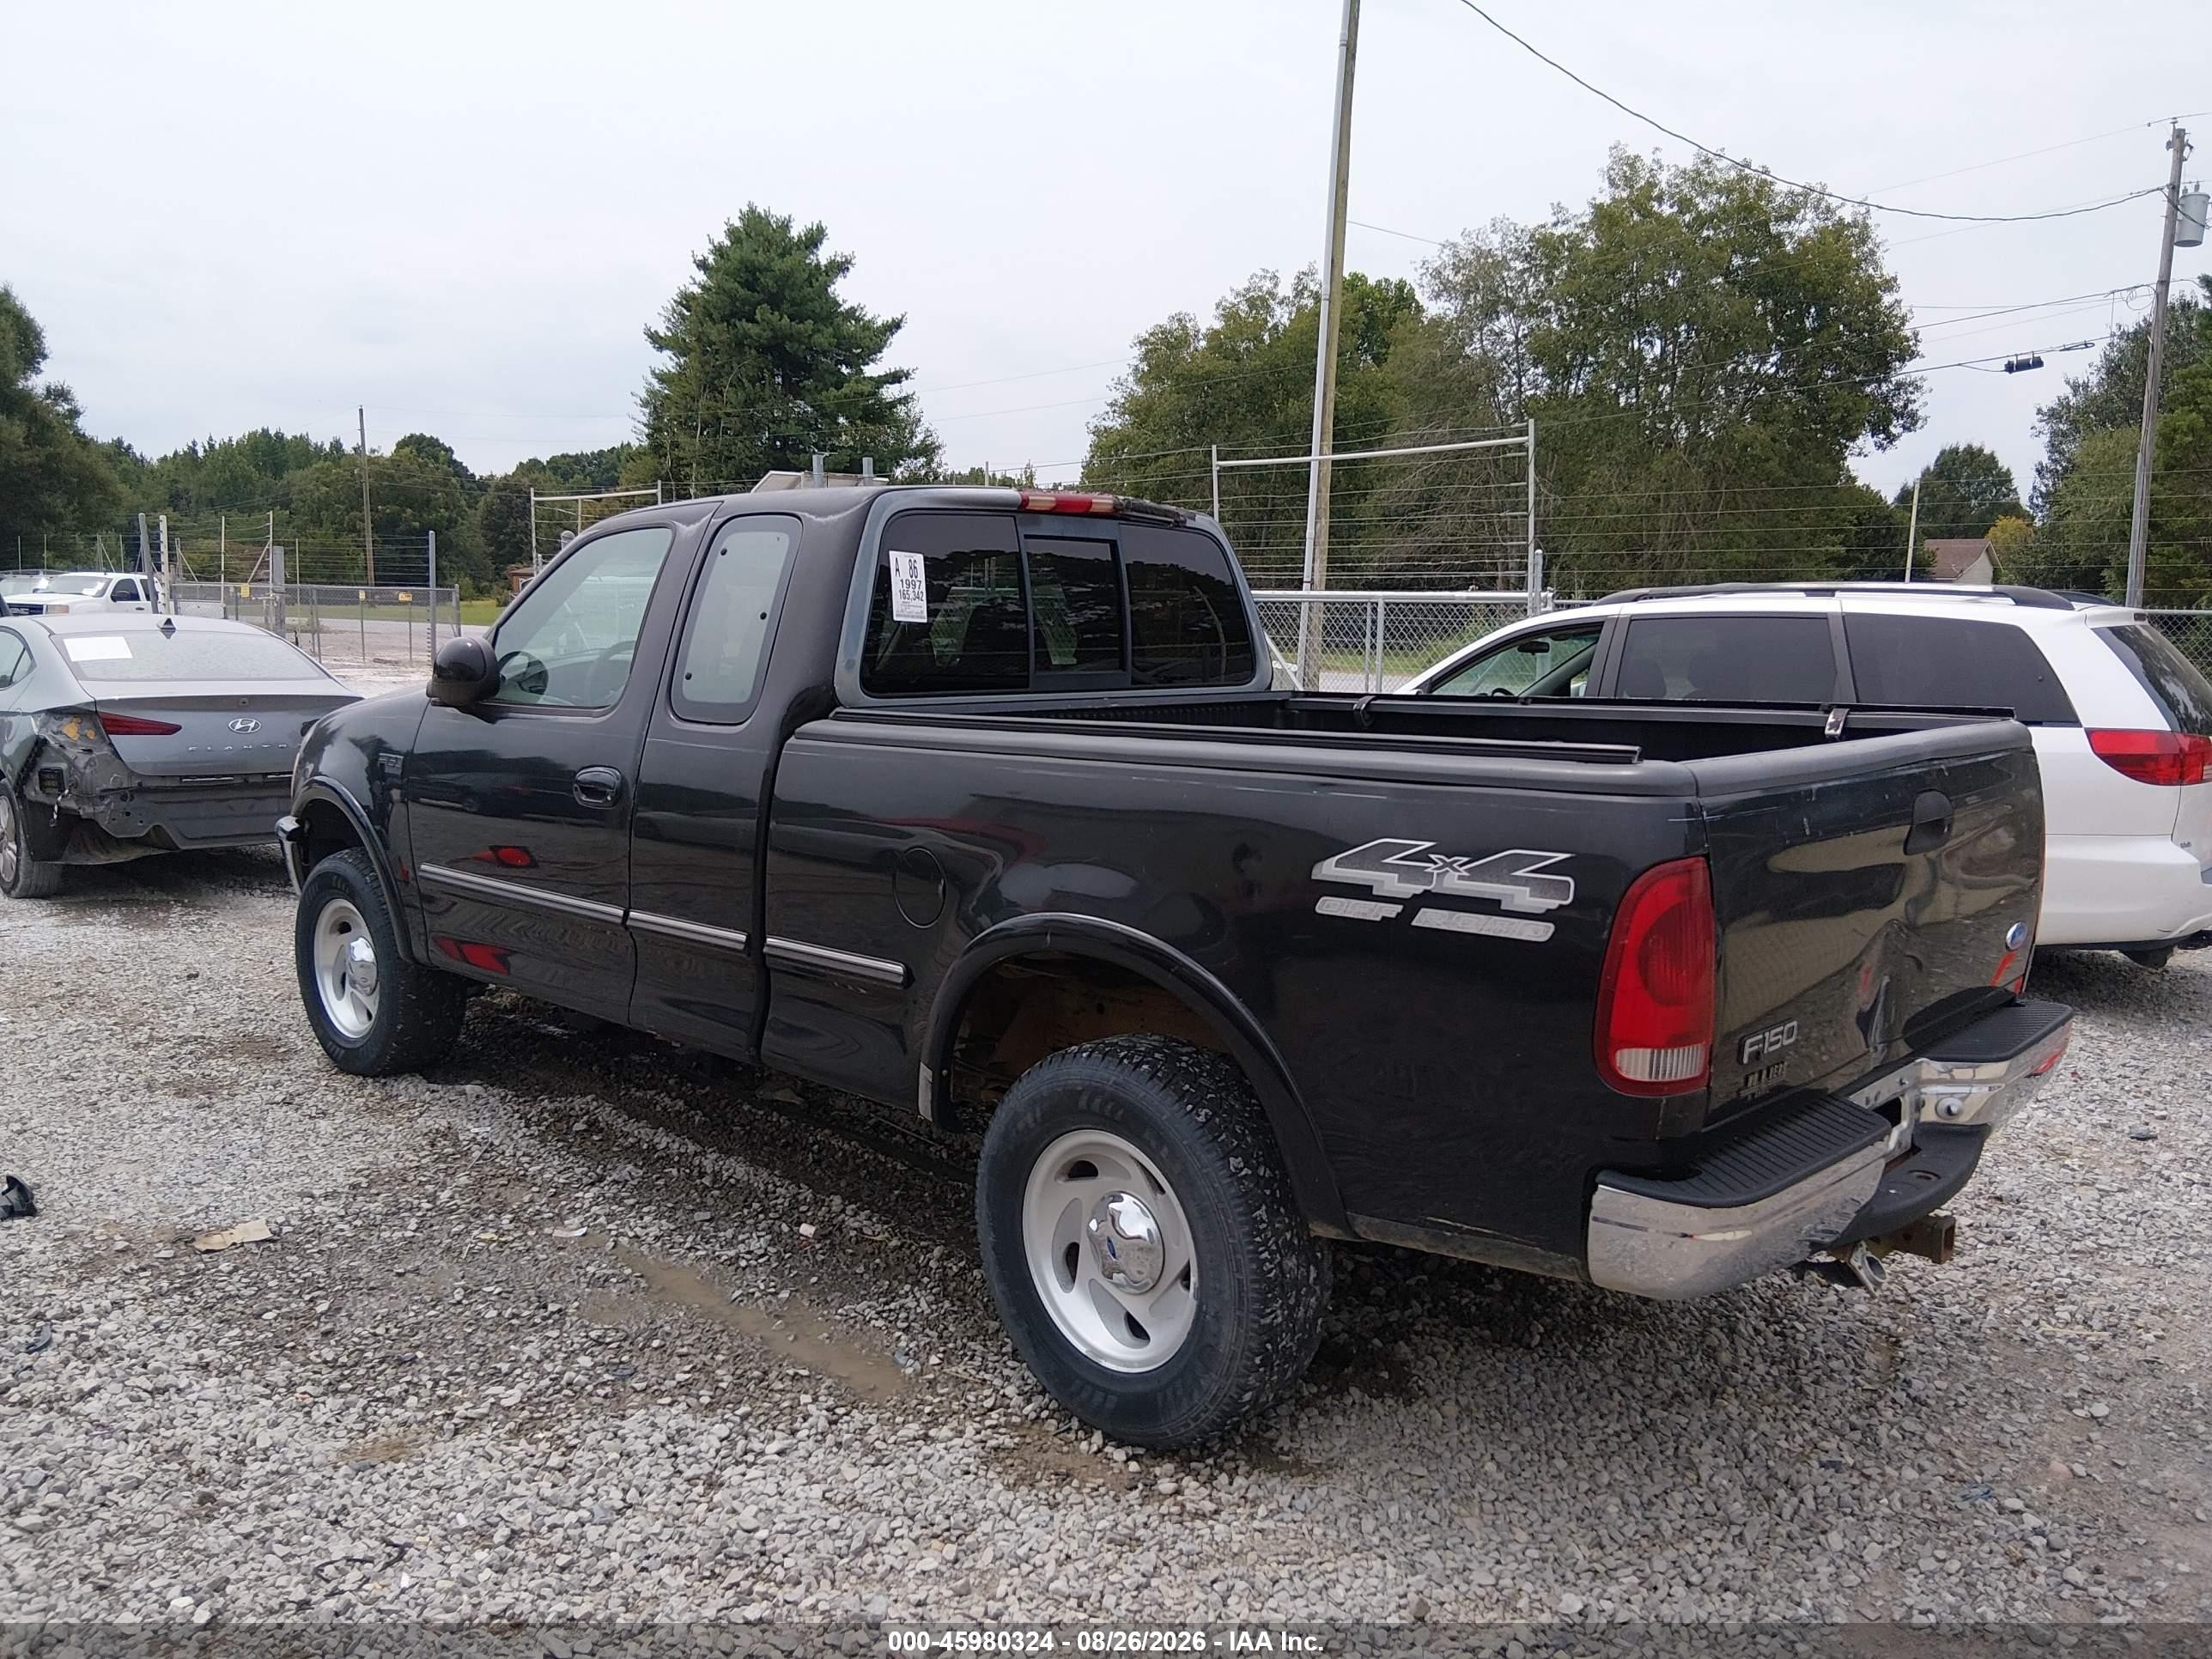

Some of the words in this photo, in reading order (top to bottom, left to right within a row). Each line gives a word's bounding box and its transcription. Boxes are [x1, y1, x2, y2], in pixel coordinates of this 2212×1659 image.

[895, 556, 901, 578] A
[908, 558, 919, 579] 86
[899, 579, 922, 591] 1997
[898, 589, 924, 602] 165,342
